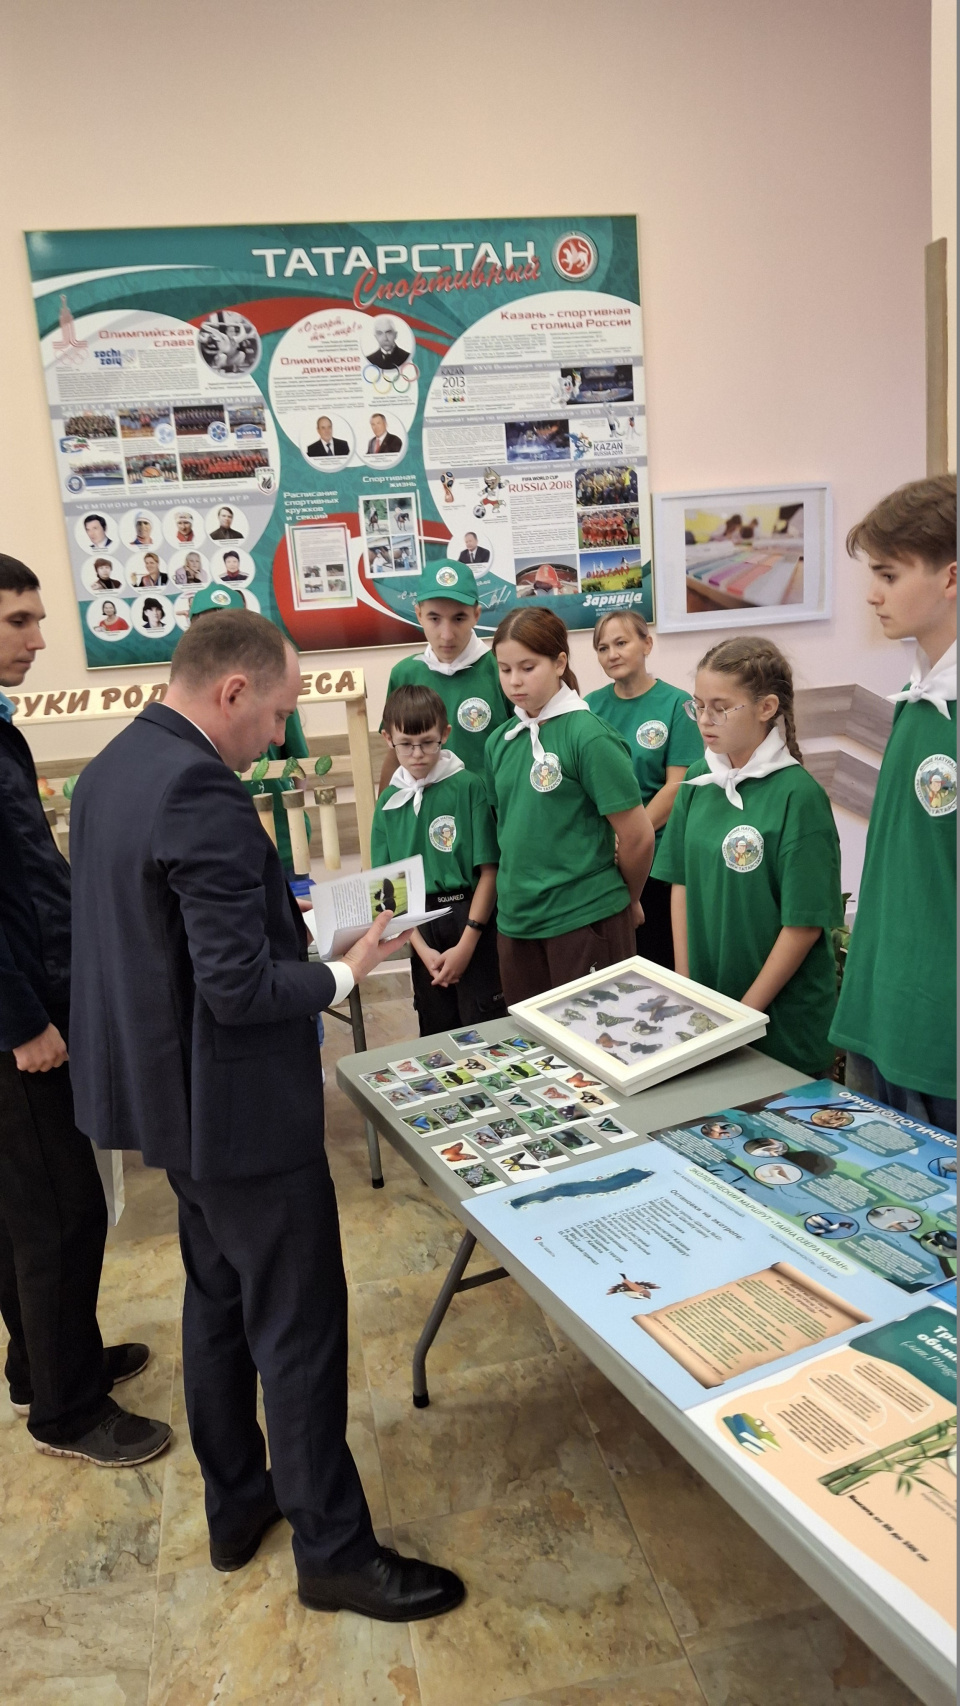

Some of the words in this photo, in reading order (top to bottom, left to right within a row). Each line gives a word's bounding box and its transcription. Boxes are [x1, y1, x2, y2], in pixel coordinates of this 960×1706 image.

[251, 241, 535, 278] ТАТАРСТАН
[353, 254, 541, 310] Спортивный
[501, 311, 546, 320] Казань
[557, 308, 631, 320] спортивная
[531, 320, 584, 331] столица
[586, 318, 632, 329] России
[98, 328, 194, 340] Олимпийская
[154, 339, 194, 348] слава
[94, 348, 120, 358] sochi
[280, 355, 361, 366] Олимпийское
[302, 366, 362, 375] движение
[440, 366, 464, 376] KAZAN
[442, 376, 466, 388] 2013
[594, 442, 623, 451] KAZAN
[362, 474, 416, 484] Спортивная
[508, 482, 548, 493] RUSSIA
[550, 480, 573, 490] 2018
[284, 490, 338, 498] Расписание
[76, 502, 138, 510] ЧЕМПИОНЫ
[143, 496, 224, 506] ОЛИМПИЙСКИХ
[284, 498, 339, 507] спортивных
[285, 506, 324, 514] кружков
[296, 512, 328, 521] секций
[582, 592, 642, 608] Зарница
[437, 894, 464, 903] SQUARED
[669, 1189, 703, 1211] Остановки
[688, 1167, 742, 1200] ЭКОЛОГИЧЕСКИЙ
[737, 1198, 772, 1220] МАРШРУТ
[794, 1235, 822, 1252] ОЗЕРА
[817, 1250, 851, 1271] КАБАН»
